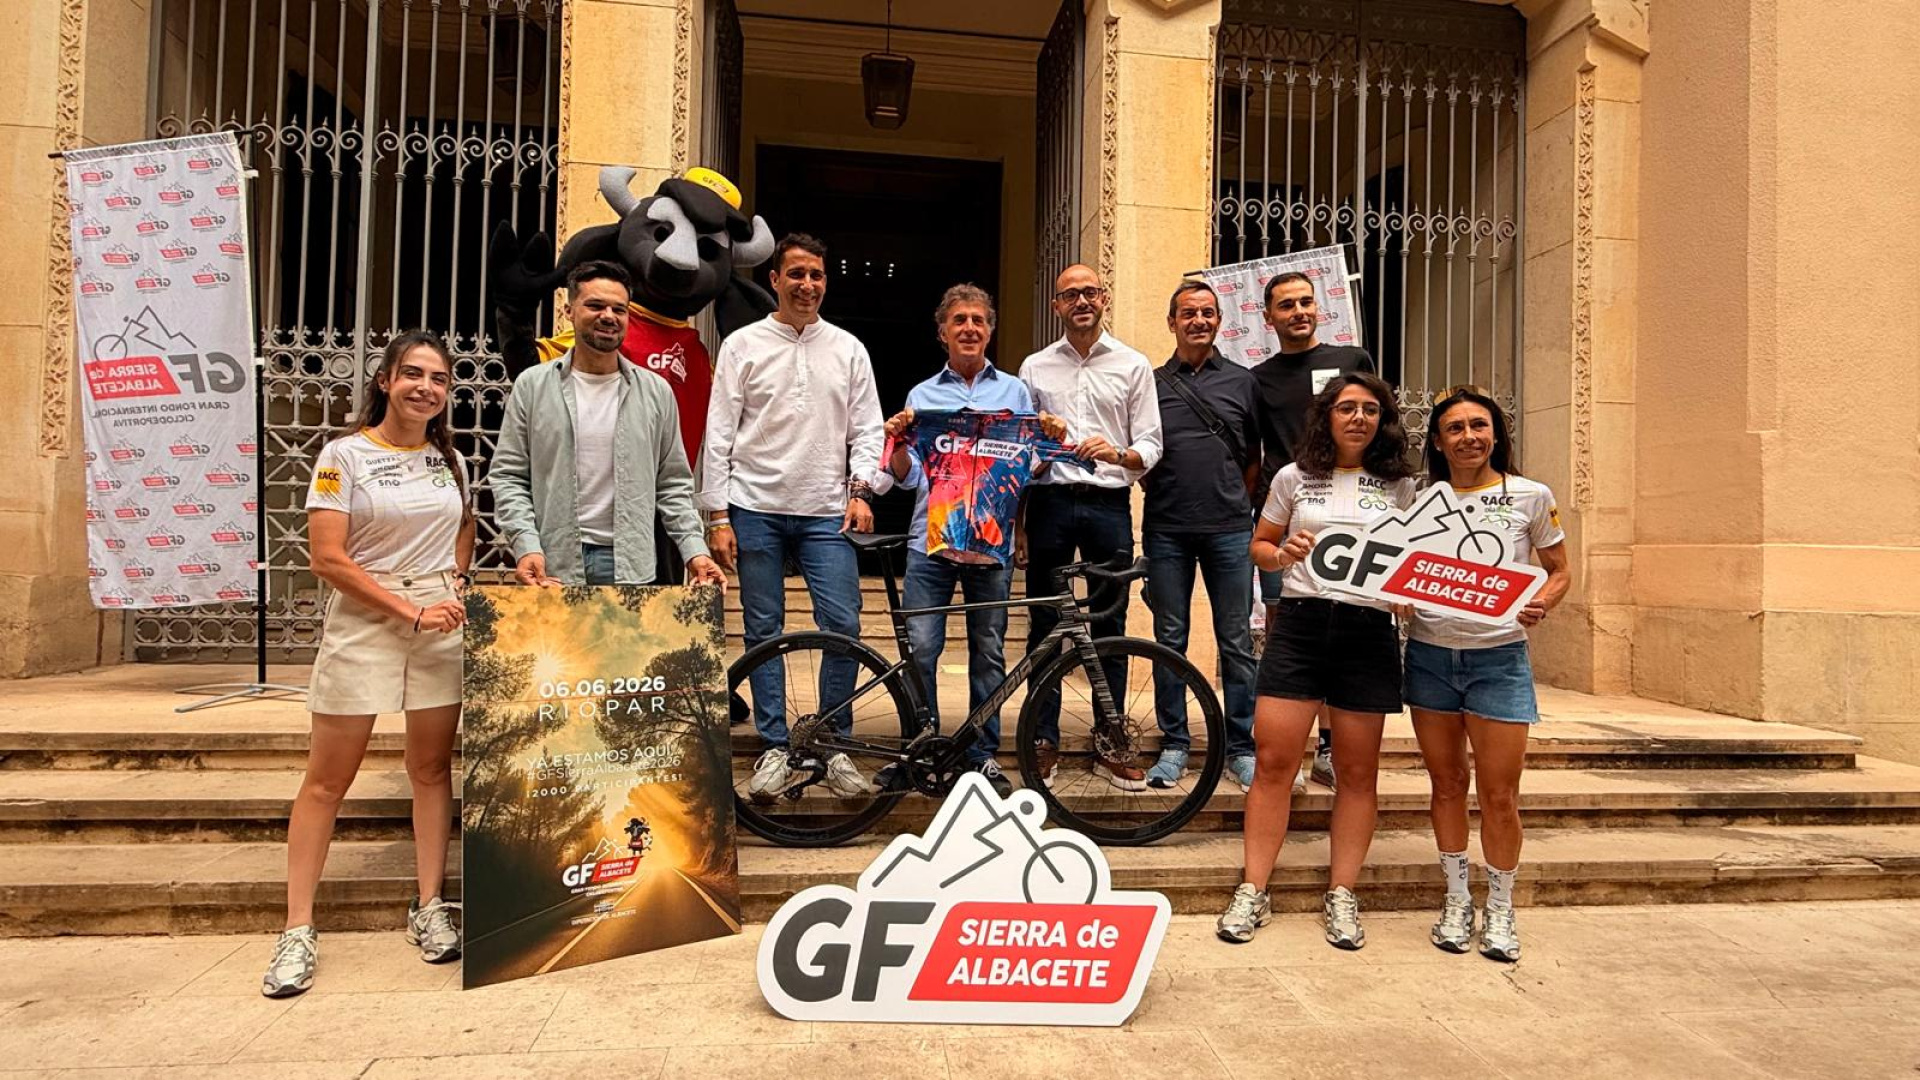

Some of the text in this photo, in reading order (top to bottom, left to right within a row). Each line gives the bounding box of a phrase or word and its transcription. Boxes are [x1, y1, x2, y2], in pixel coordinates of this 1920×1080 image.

[647, 353, 674, 370] GF
[935, 434, 970, 454] GF
[978, 448, 1013, 458] ALBACETE
[983, 442, 1007, 450] SIERRA
[425, 456, 451, 468] RAC
[317, 471, 340, 482] RACC
[1358, 476, 1387, 490] RACC
[1480, 496, 1514, 506] RACC
[1311, 533, 1405, 588] GF
[1412, 559, 1509, 591] SIERRA de
[1403, 577, 1500, 609] ALBACETE
[539, 676, 666, 698] 06.06.2026
[526, 756, 548, 769] YA
[553, 748, 629, 768] ESTAMOS
[562, 863, 596, 887] GF
[957, 918, 1120, 948] SIERRA de
[772, 897, 937, 1003] GF
[946, 956, 1111, 987] ALBACETE
